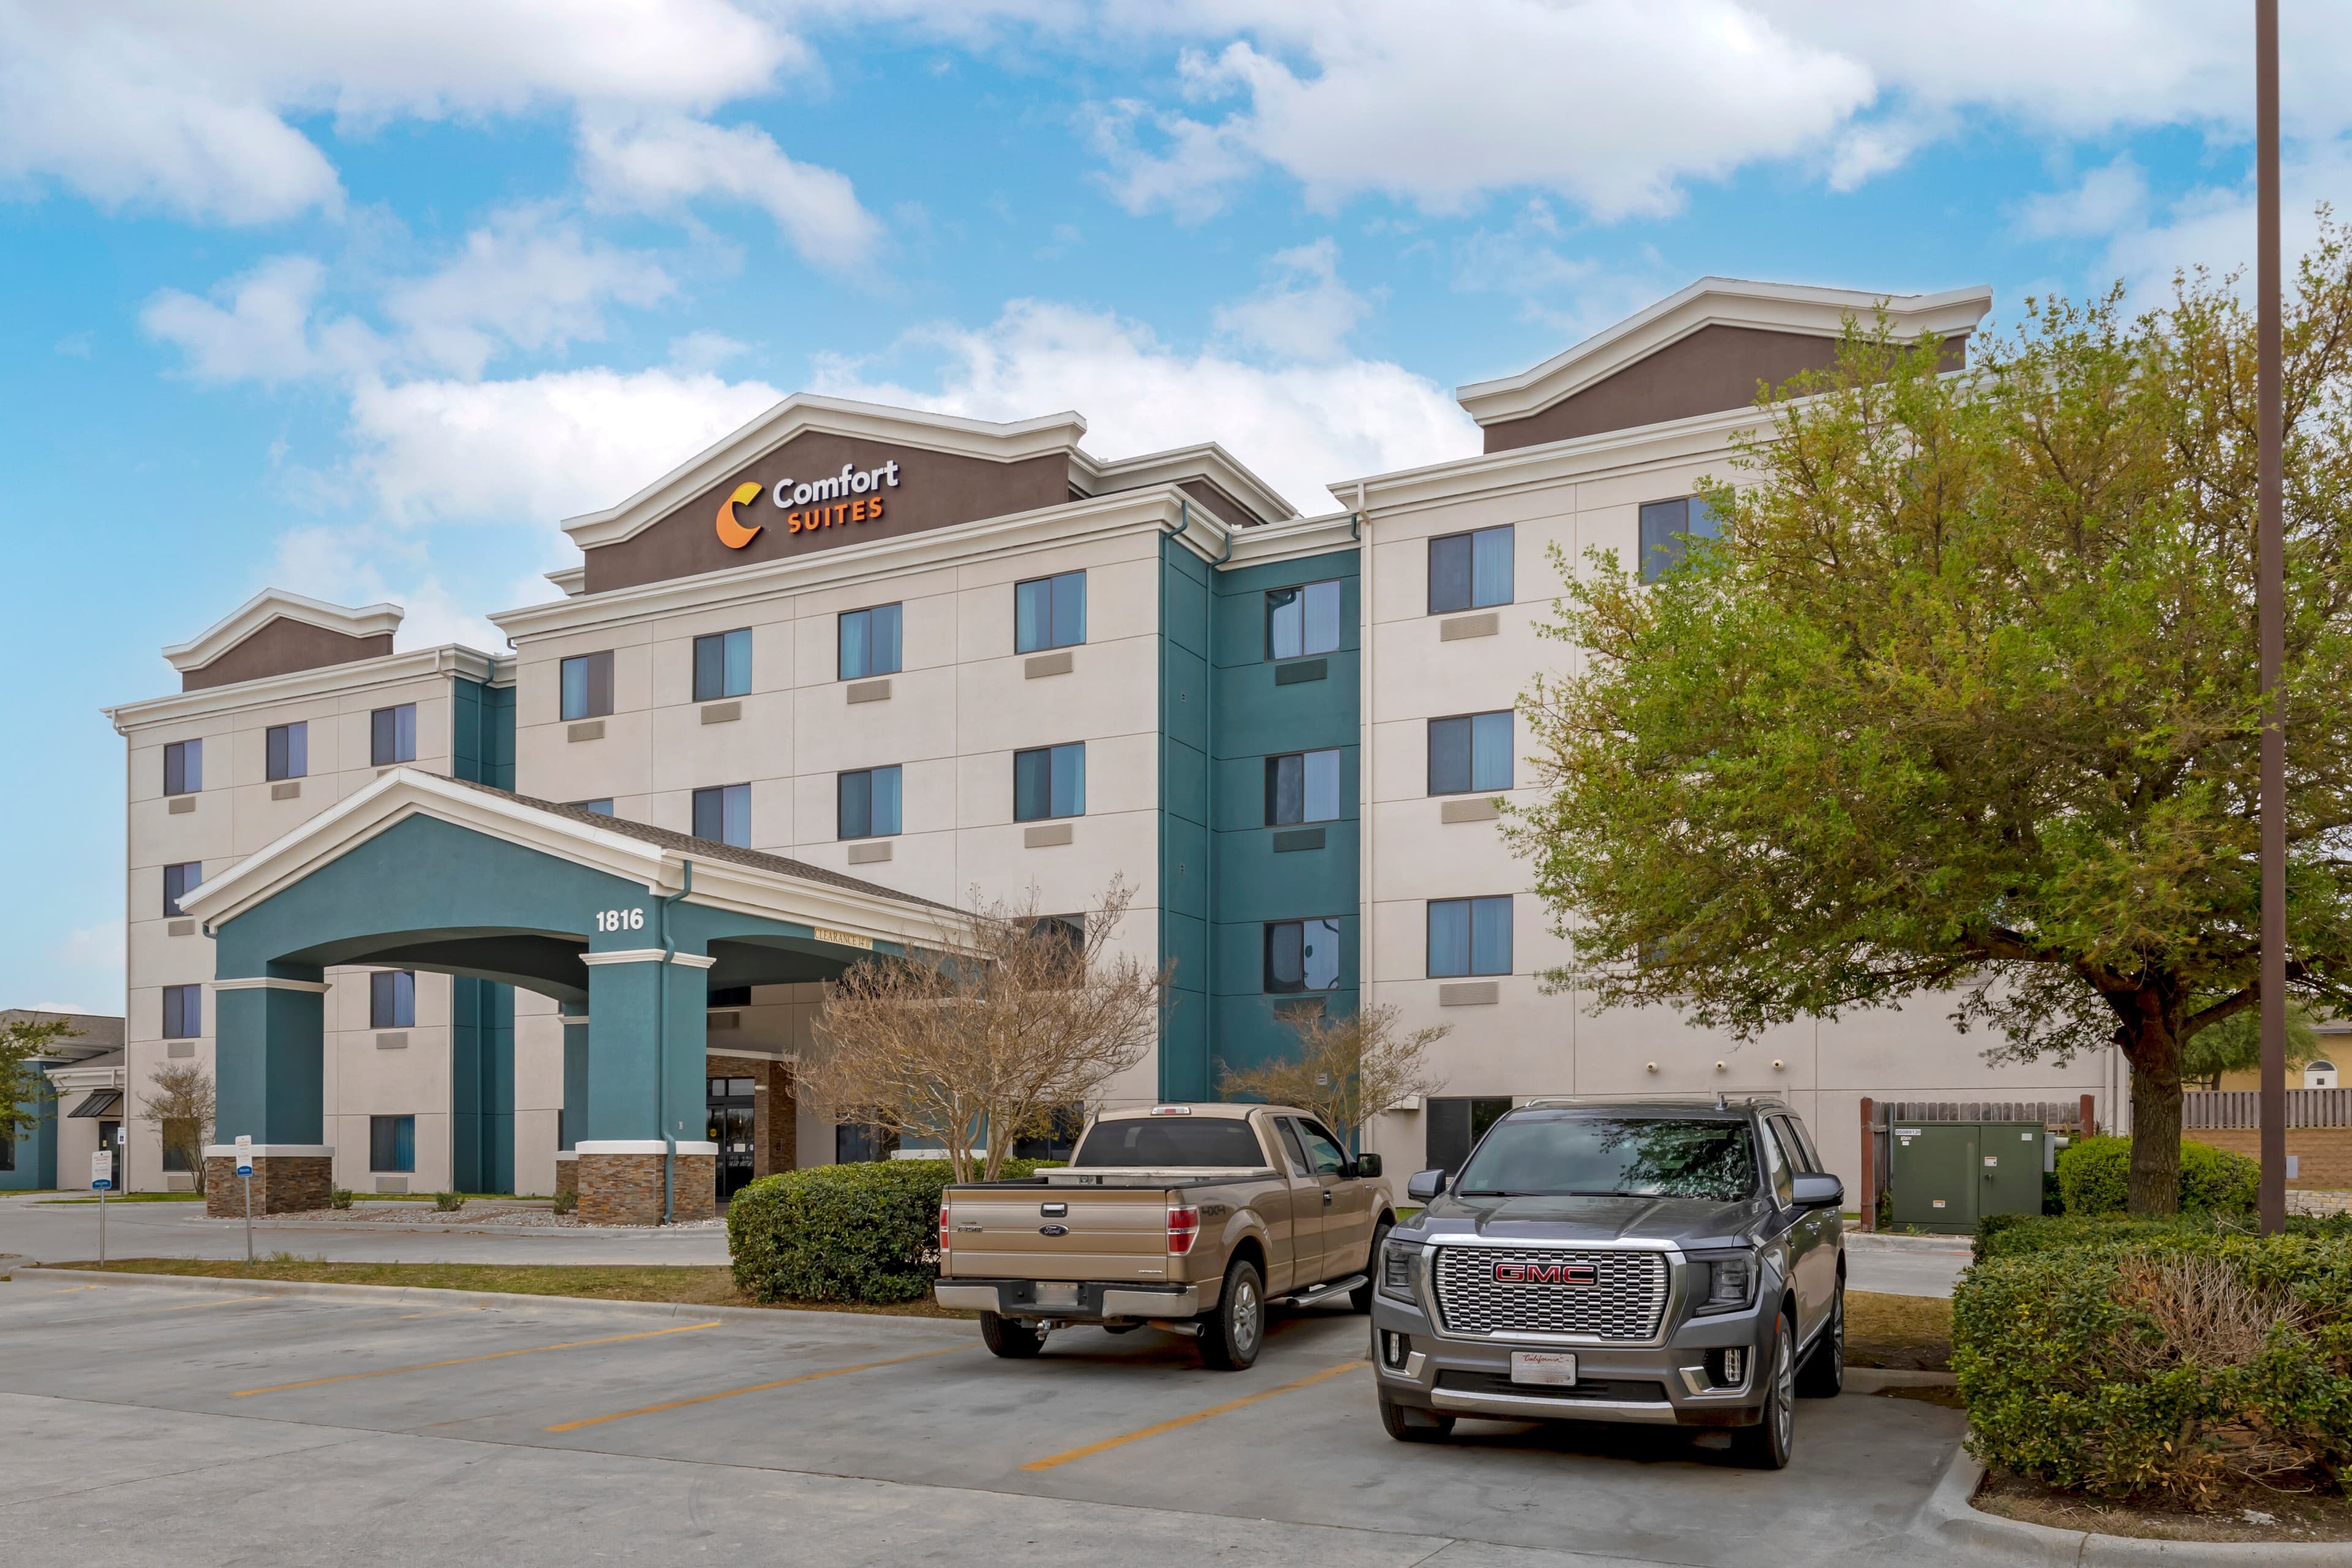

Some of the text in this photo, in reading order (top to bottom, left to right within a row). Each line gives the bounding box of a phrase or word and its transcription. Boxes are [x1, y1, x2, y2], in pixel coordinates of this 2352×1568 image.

[773, 460, 899, 509] Comfort
[787, 496, 883, 534] SUITES
[596, 908, 644, 932] 1816
[815, 928, 857, 946] CLEARANCE
[1044, 1226, 1061, 1235] Ford
[1496, 1264, 1594, 1284] GMC
[1523, 1354, 1563, 1364] California
